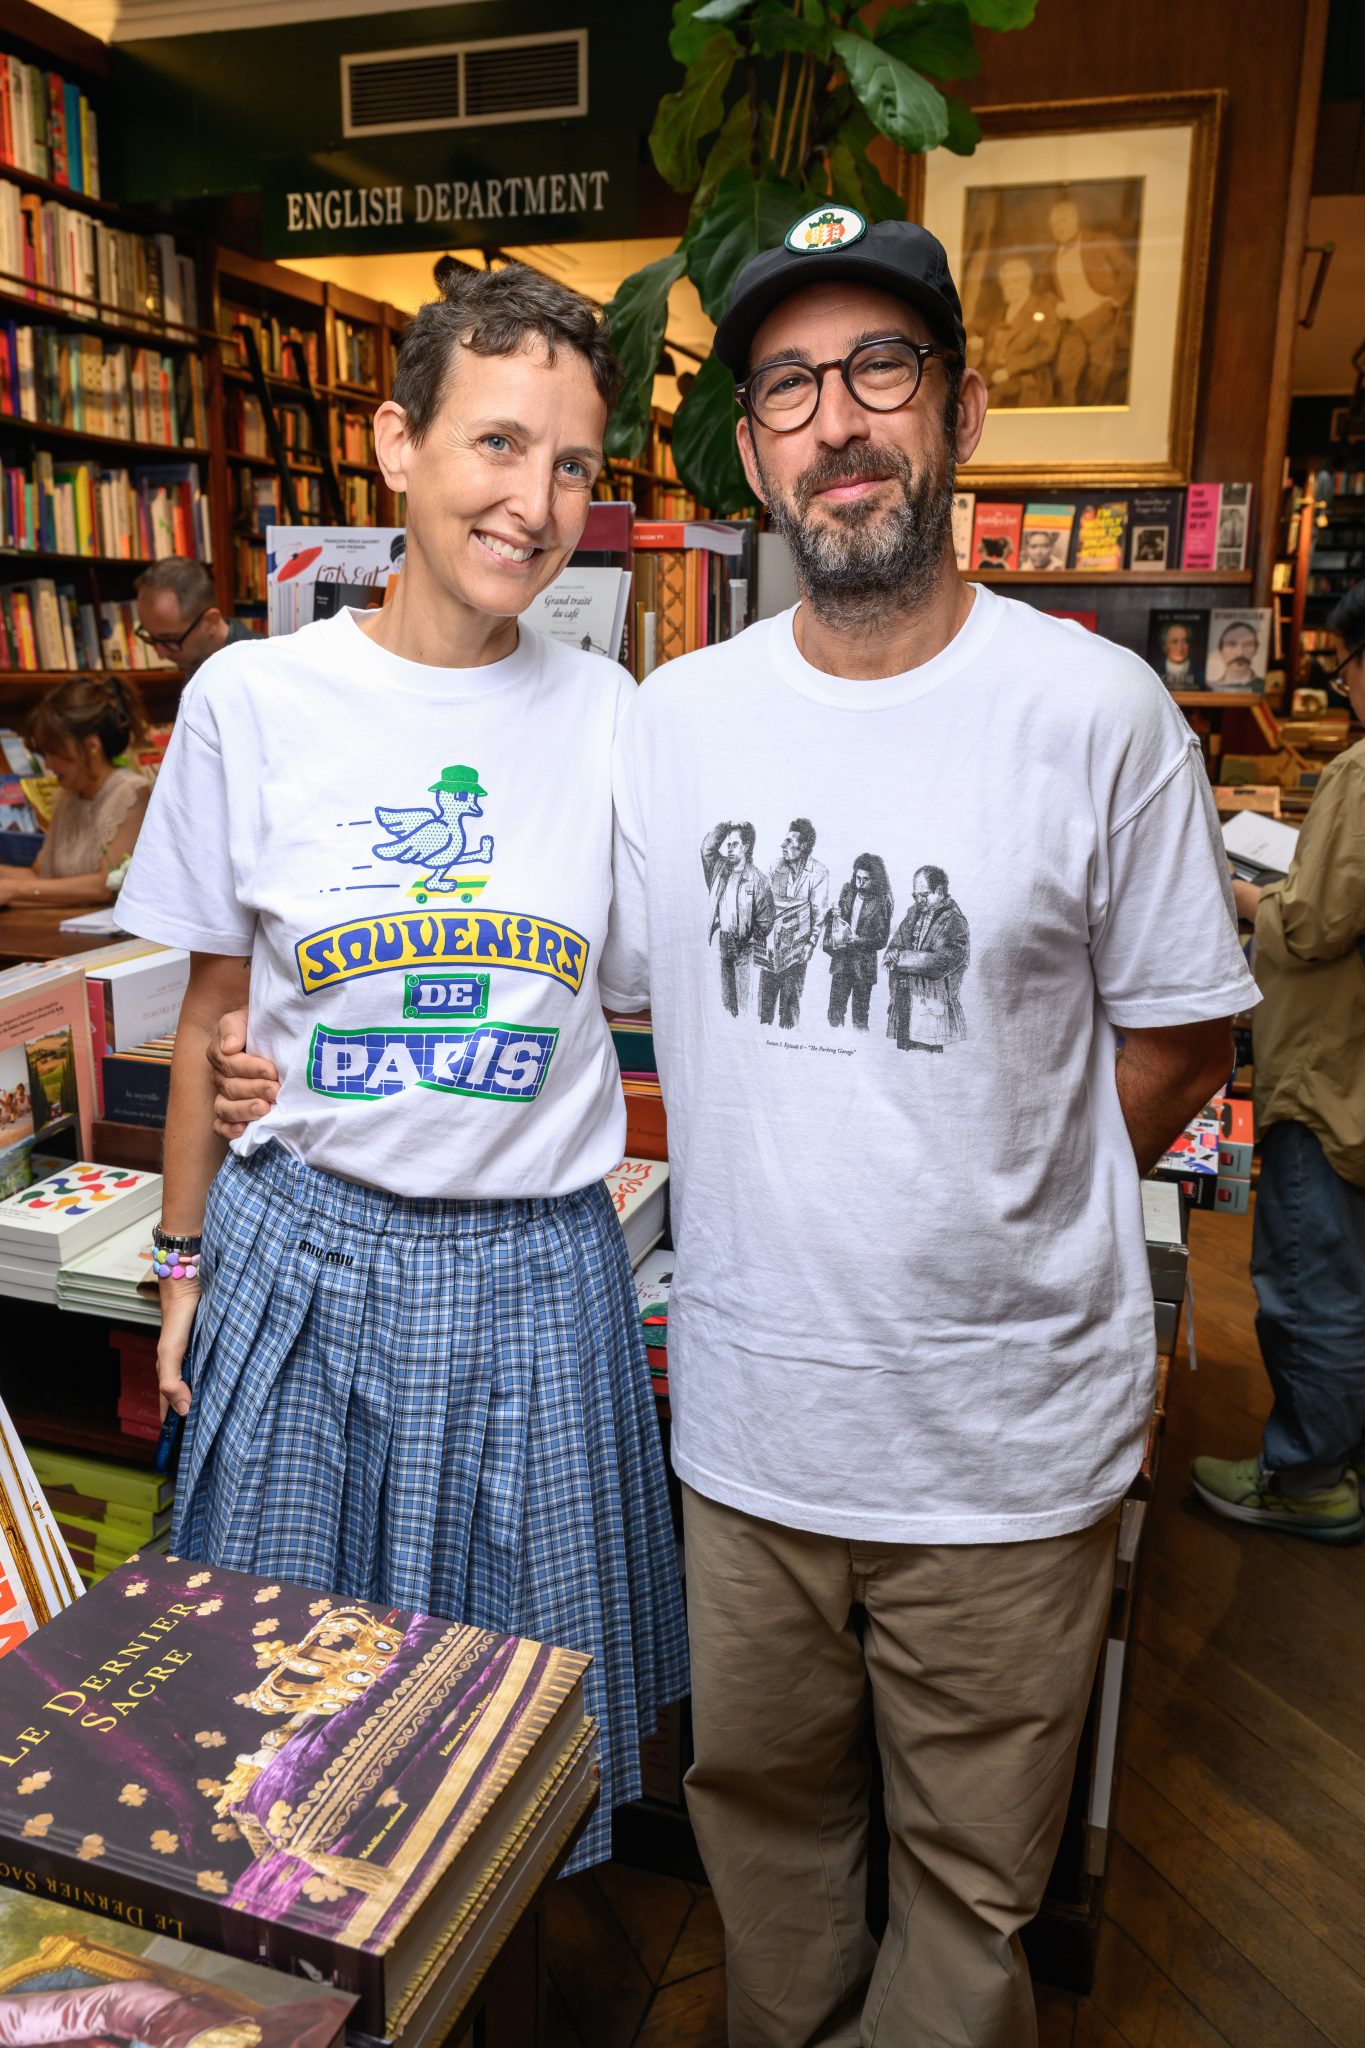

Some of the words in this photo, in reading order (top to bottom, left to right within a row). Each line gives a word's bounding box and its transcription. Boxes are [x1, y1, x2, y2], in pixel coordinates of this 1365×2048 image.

[286, 186, 404, 232] ENGLISH
[415, 170, 609, 223] DEPARTMENT
[351, 566, 389, 587] Eat
[544, 594, 570, 608] Grand
[570, 595, 592, 606] traité
[552, 607, 563, 618] du
[564, 607, 580, 621] café
[418, 983, 473, 1007] DE
[321, 1036, 543, 1089] PARIS
[299, 1240, 323, 1259] miu
[326, 1251, 354, 1267] miu
[0, 1726, 51, 1768] LE
[43, 1601, 197, 1718] DERNIER
[81, 1649, 193, 1733] SACRE
[47, 1878, 144, 1928] DERNIER
[155, 1913, 184, 1941] LE
